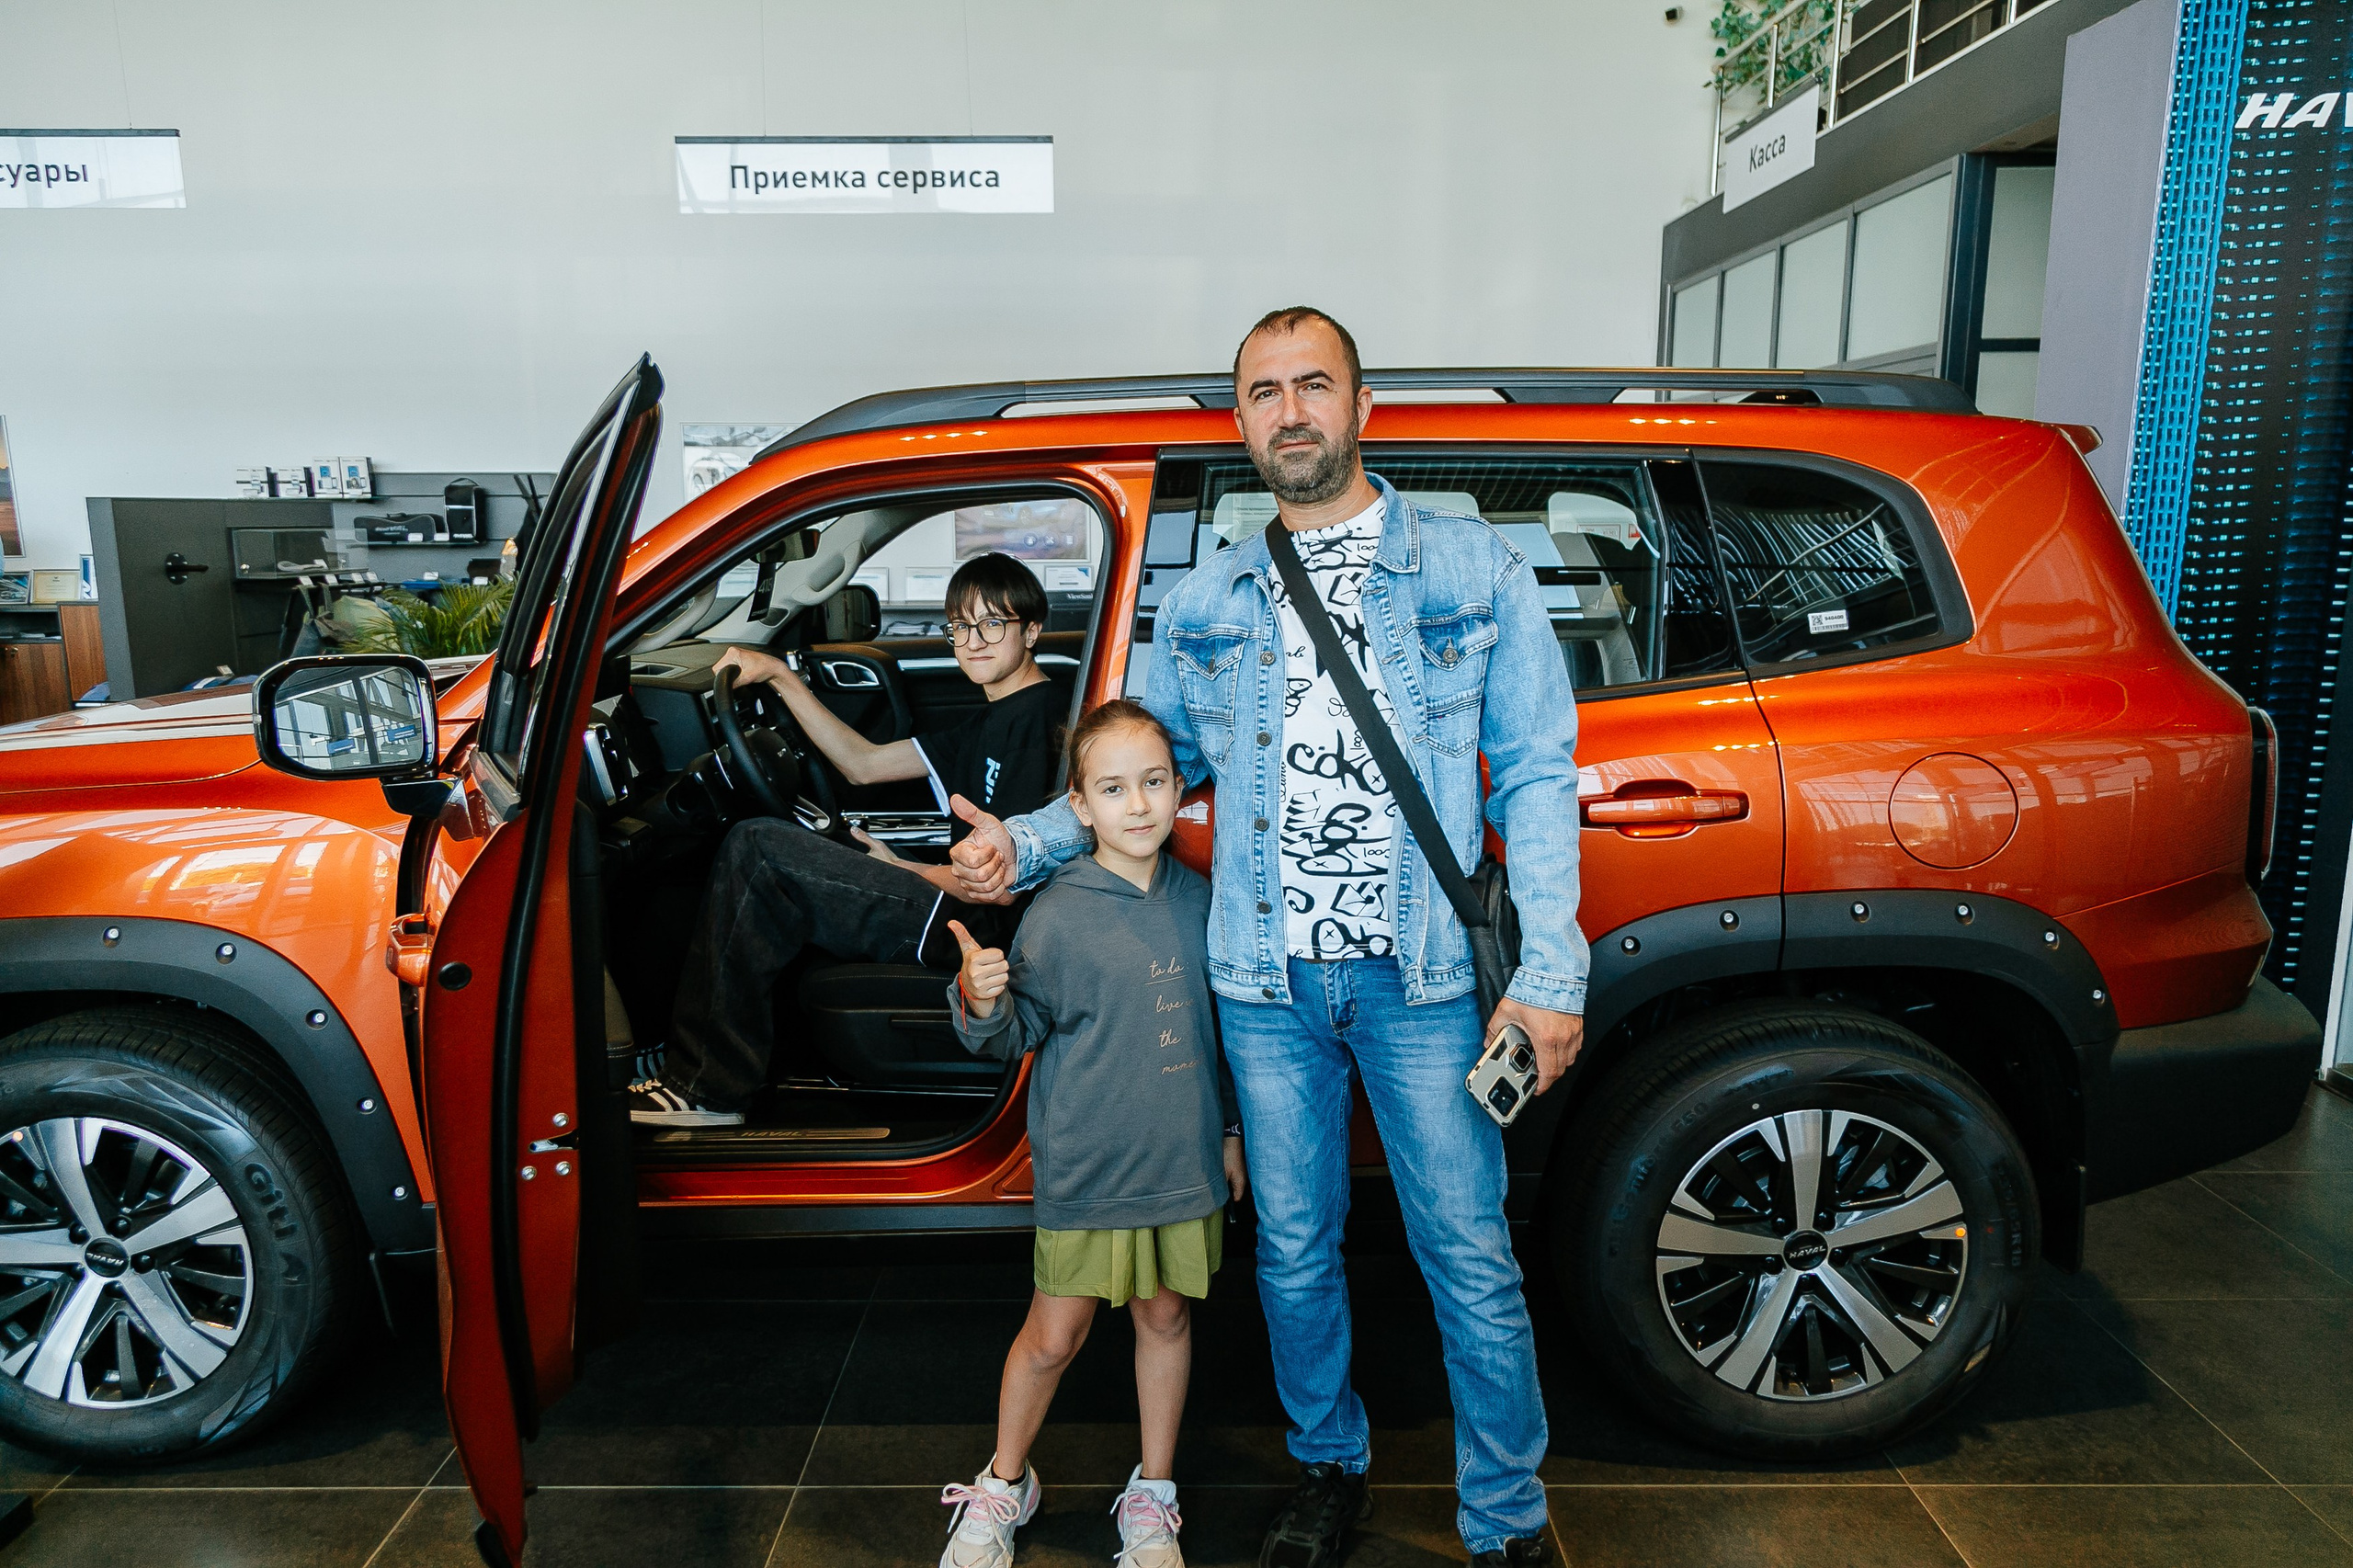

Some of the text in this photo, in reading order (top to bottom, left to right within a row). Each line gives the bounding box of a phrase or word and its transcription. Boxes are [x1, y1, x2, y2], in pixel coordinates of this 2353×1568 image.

[2234, 92, 2353, 129] HA
[1749, 133, 1786, 173] Касса
[730, 165, 1001, 195] Приемка сервиса
[1155, 994, 1185, 1014] live
[1158, 1028, 1183, 1049] the
[1789, 1245, 1825, 1259] HAVAL
